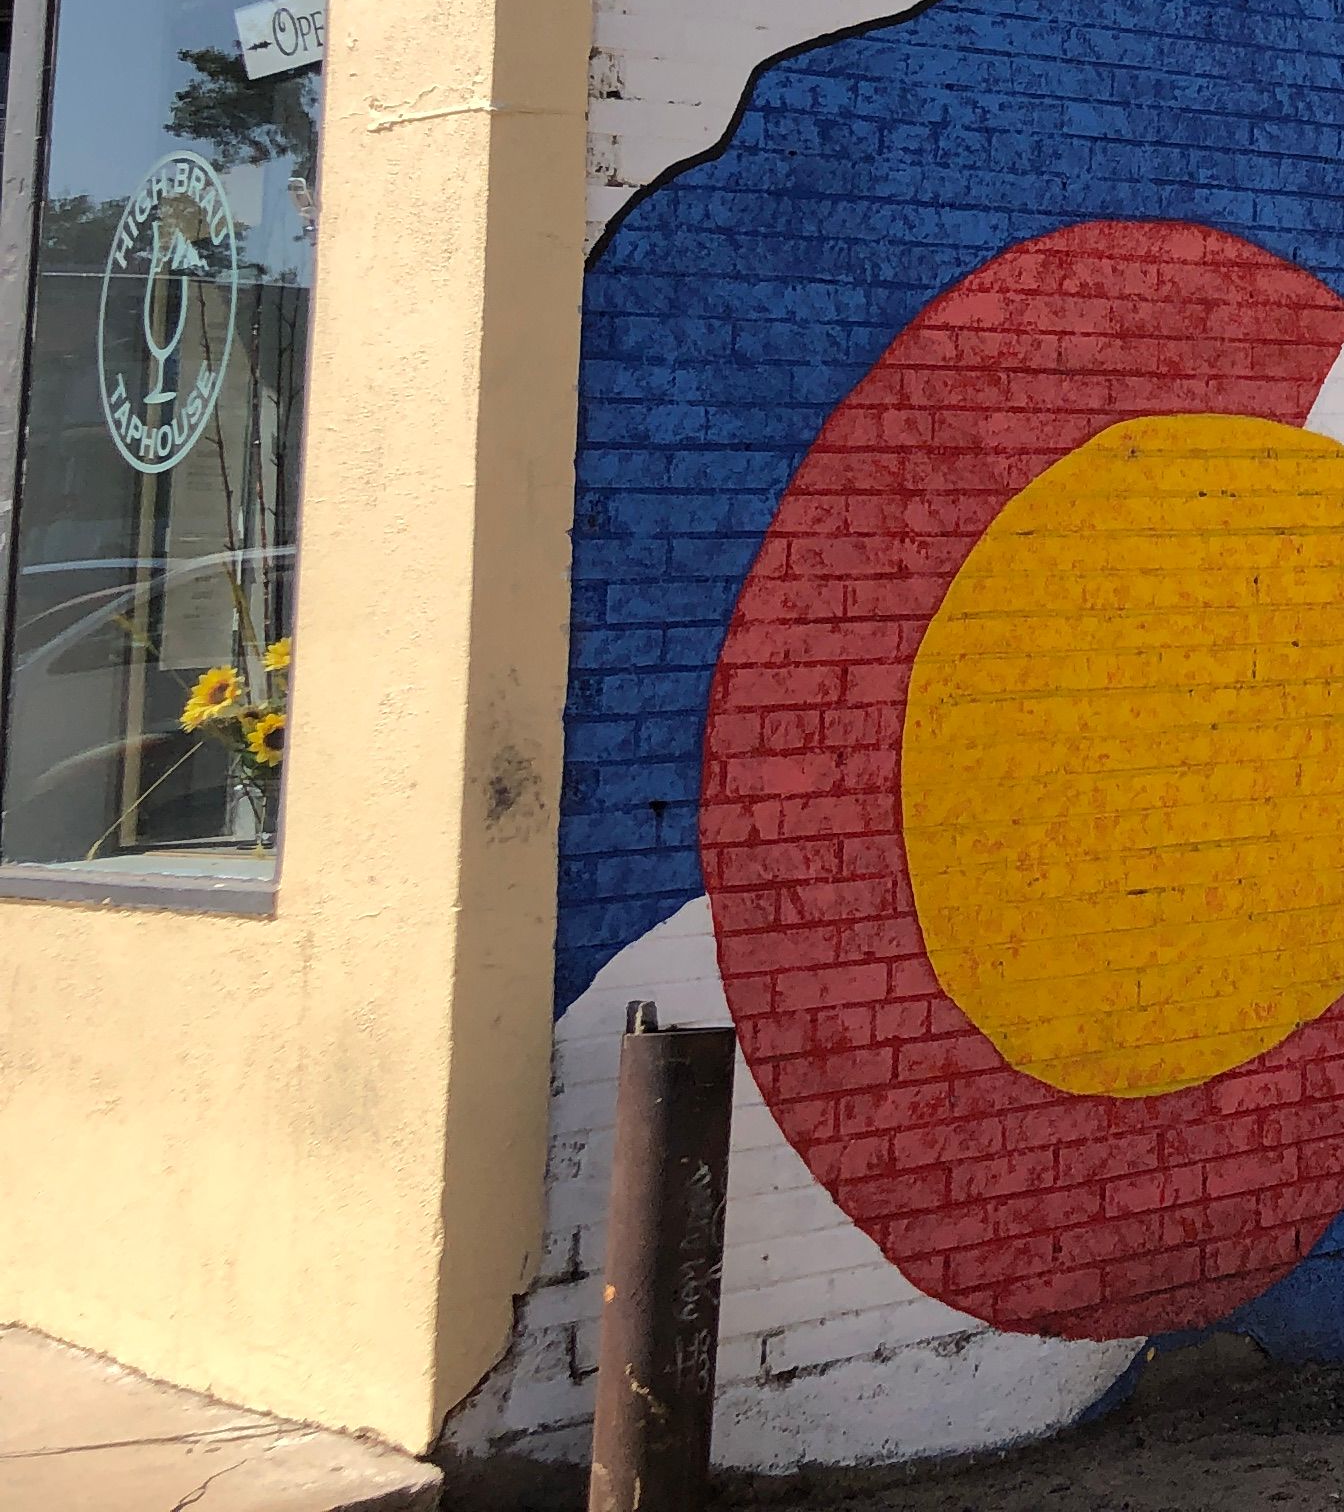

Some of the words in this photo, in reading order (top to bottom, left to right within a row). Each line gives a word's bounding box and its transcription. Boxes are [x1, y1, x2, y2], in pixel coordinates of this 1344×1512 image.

[272, 7, 325, 57] OPE
[114, 168, 168, 270] HIGH
[110, 359, 217, 460] TAPHOUSE
